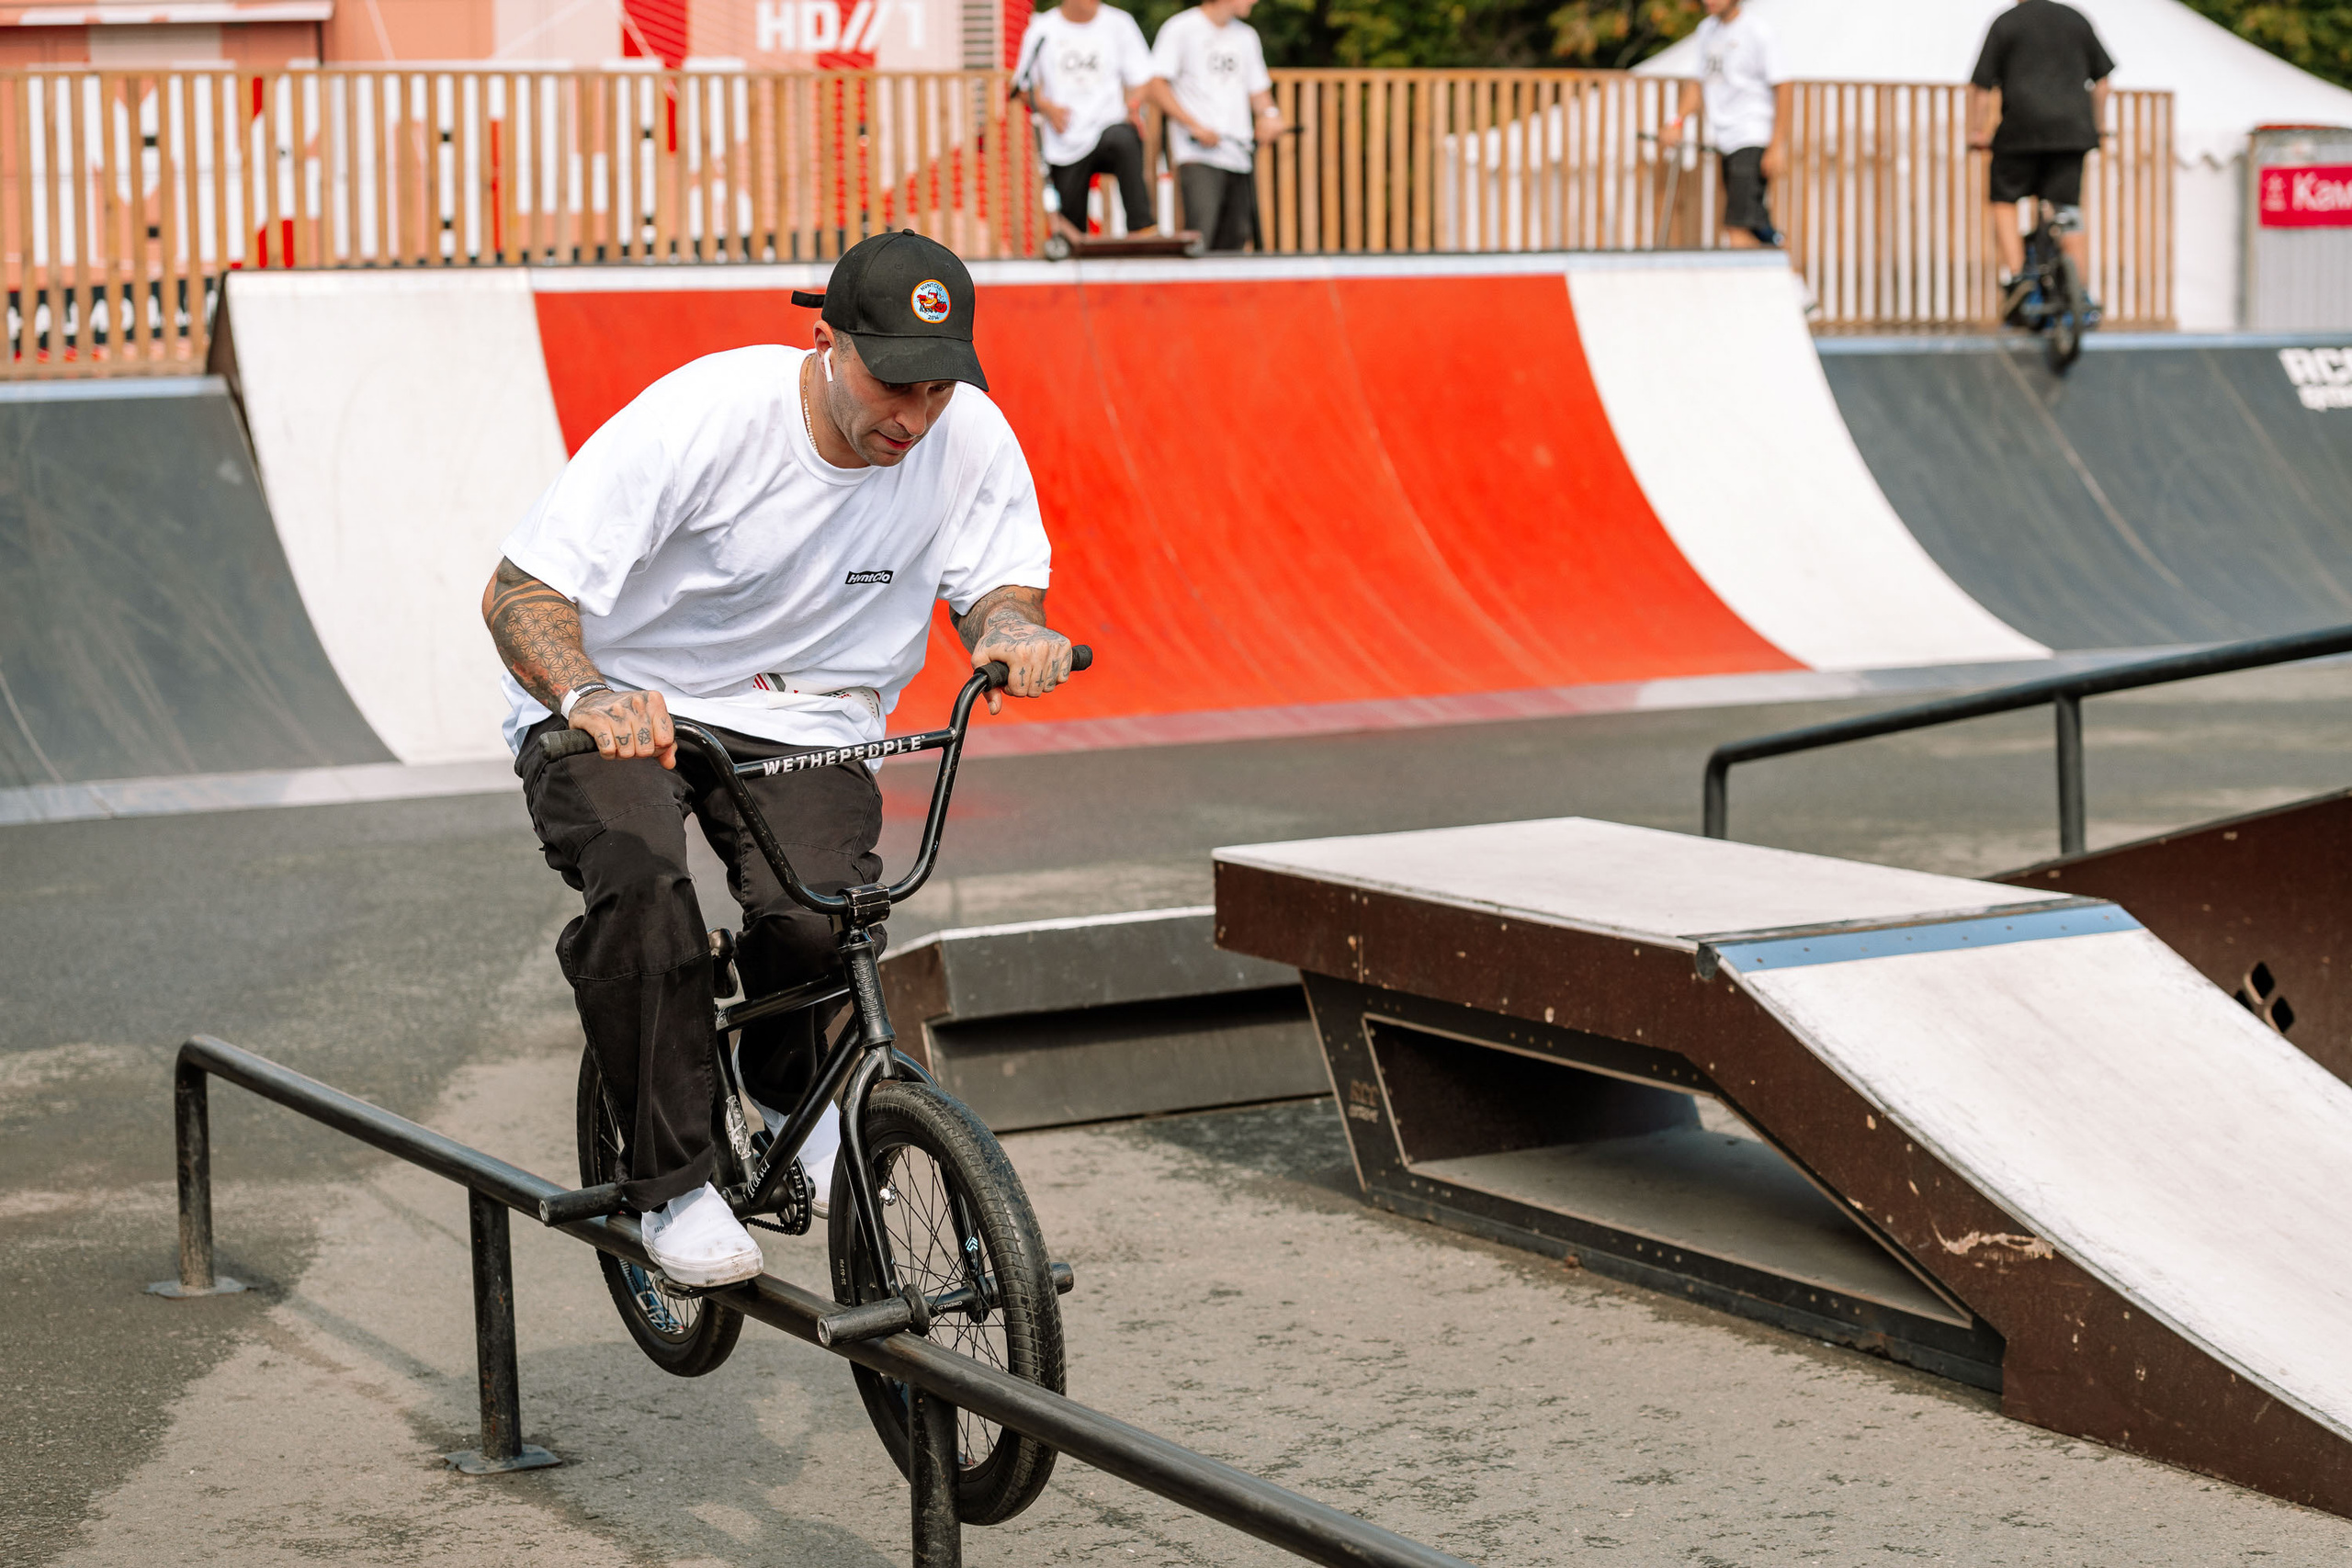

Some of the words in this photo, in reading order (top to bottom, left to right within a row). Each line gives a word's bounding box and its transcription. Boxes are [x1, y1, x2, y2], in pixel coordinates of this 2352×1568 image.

[763, 736, 922, 776] WETHEPEOPLE
[851, 958, 876, 997] CREW
[861, 997, 881, 1024] THE
